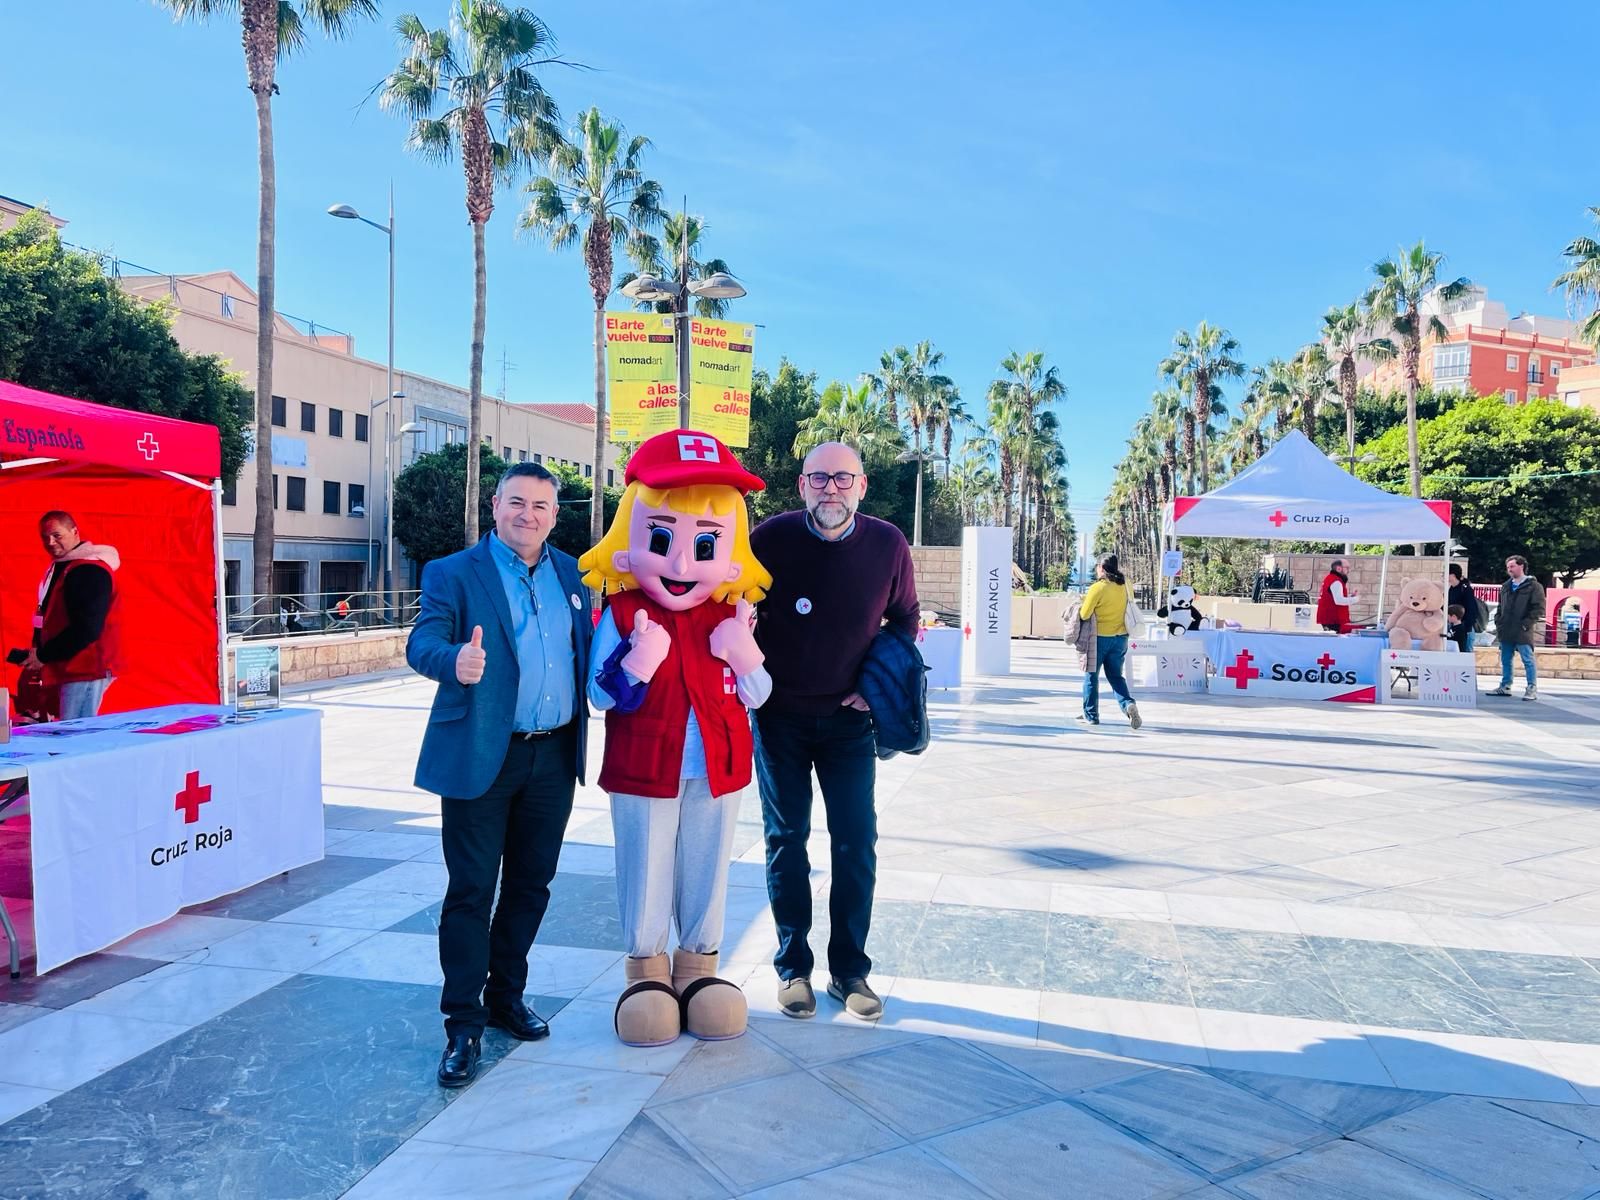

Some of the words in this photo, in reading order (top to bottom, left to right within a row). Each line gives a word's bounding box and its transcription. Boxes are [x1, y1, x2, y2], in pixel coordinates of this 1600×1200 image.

[606, 318, 620, 330] El
[620, 320, 645, 330] arte
[691, 322, 703, 334] El
[703, 326, 727, 337] arte
[607, 332, 647, 342] vuelve
[691, 336, 728, 349] vuelve
[619, 356, 663, 366] nomadart
[700, 360, 741, 373] nomadart
[647, 385, 655, 395] a
[657, 383, 677, 395] las
[723, 392, 731, 401] a
[733, 390, 750, 402] las
[638, 397, 678, 409] calles
[713, 403, 750, 416] calles
[4, 419, 85, 452] Española
[1293, 514, 1321, 523] Cruz
[1323, 514, 1350, 526] Roja
[988, 567, 999, 634] INFANCIA
[1271, 663, 1357, 685] Socios
[151, 839, 188, 866] Cruz
[195, 826, 233, 851] Roja
